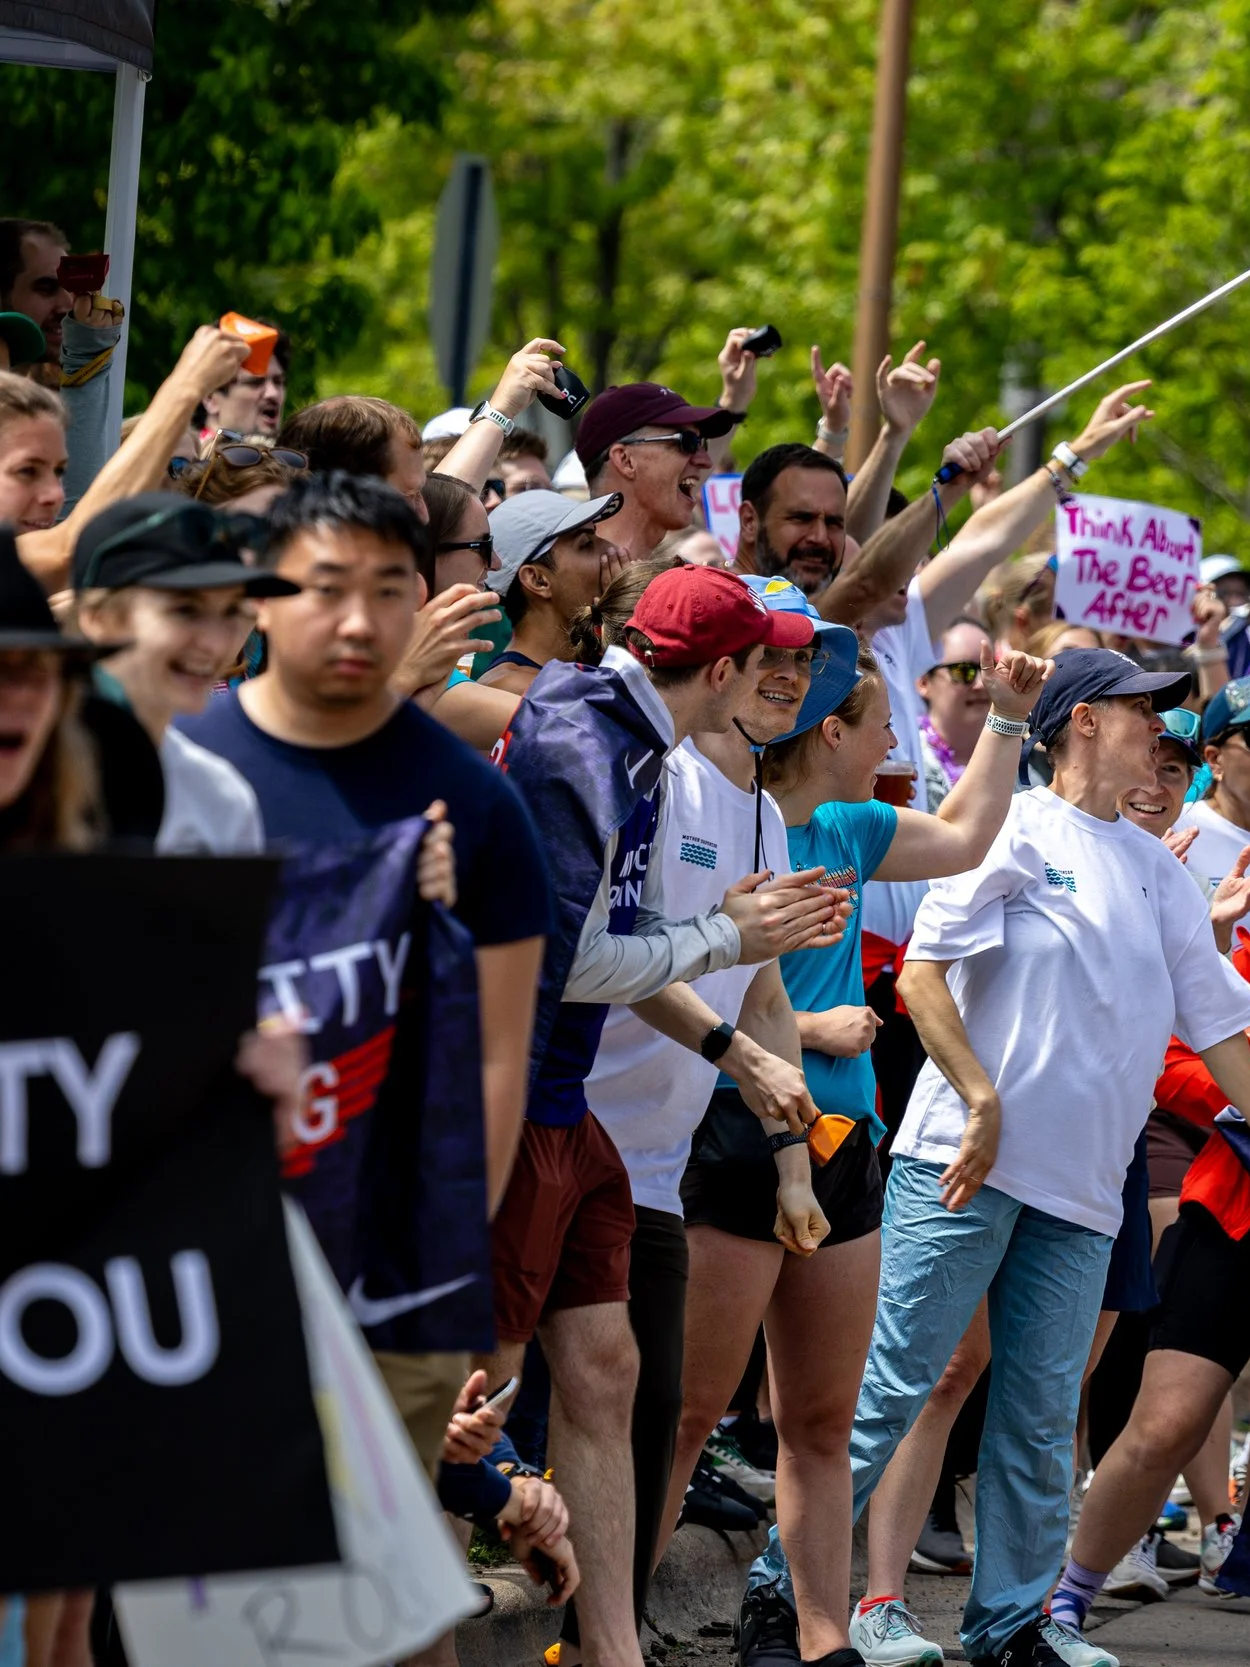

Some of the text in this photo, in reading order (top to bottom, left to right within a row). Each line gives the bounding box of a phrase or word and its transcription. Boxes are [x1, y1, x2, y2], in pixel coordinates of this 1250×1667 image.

[1139, 518, 1195, 567] About
[1072, 548, 1197, 605] The Beer
[1082, 590, 1169, 635] After
